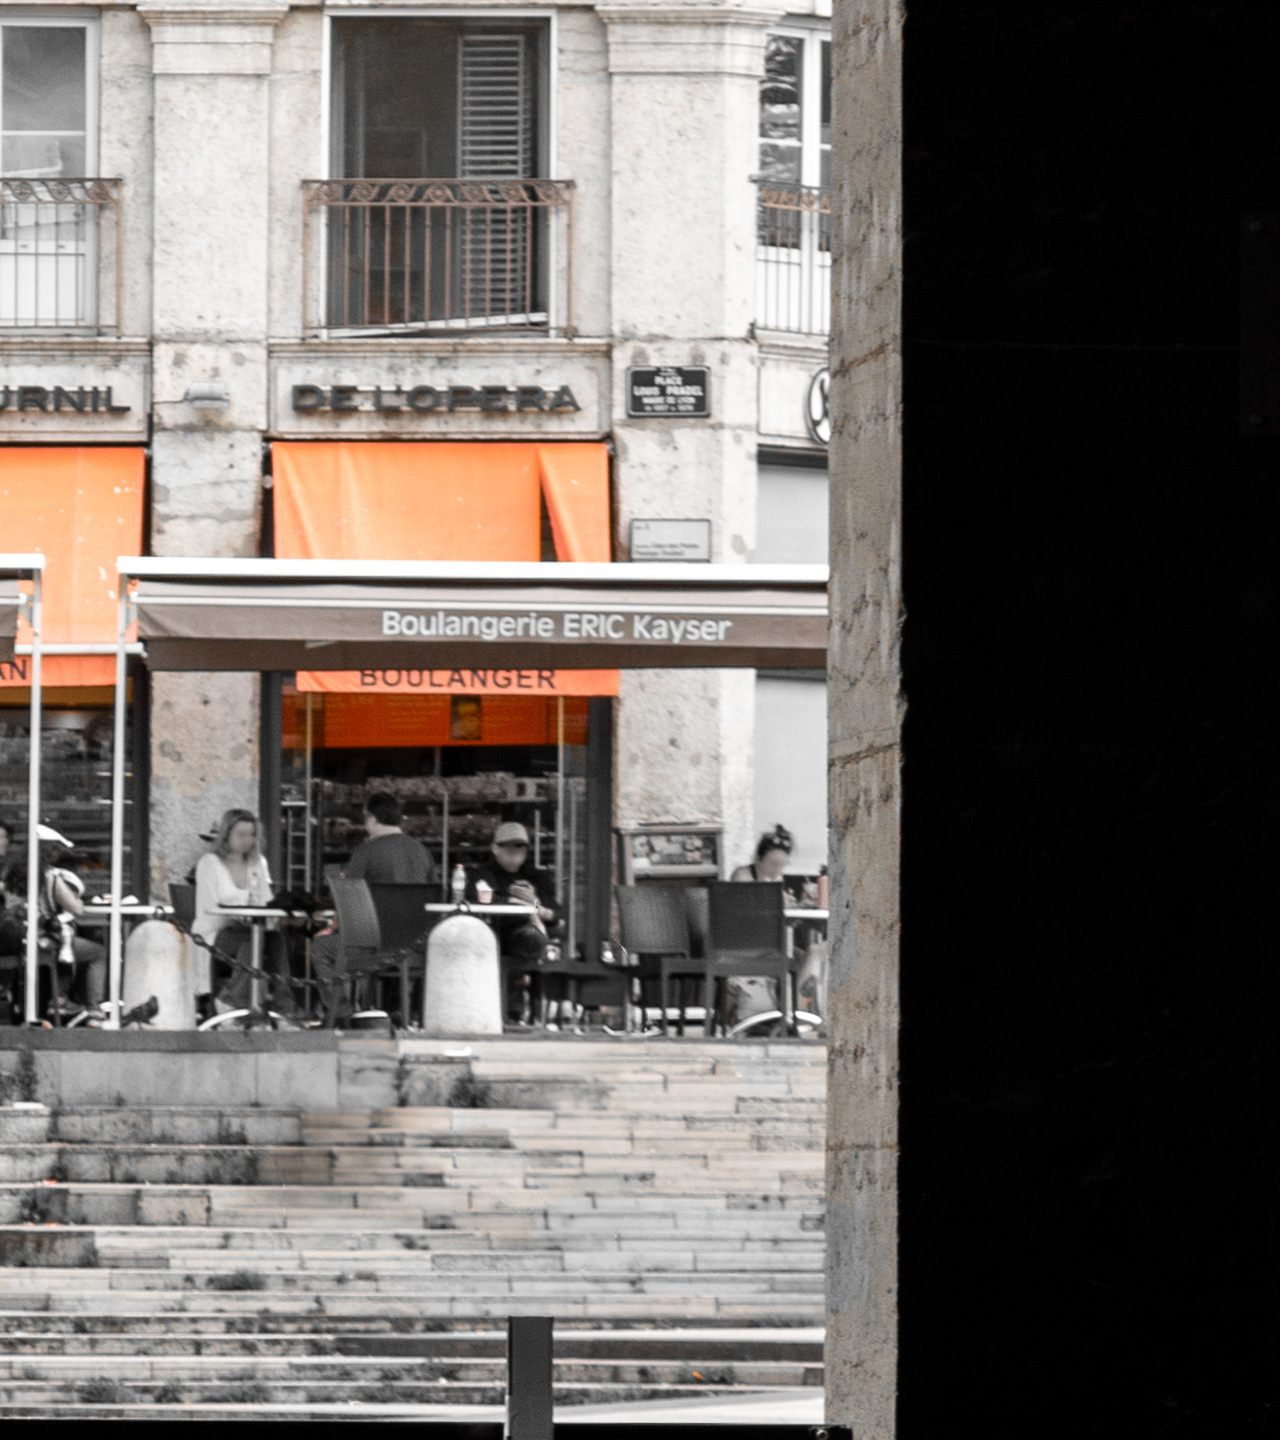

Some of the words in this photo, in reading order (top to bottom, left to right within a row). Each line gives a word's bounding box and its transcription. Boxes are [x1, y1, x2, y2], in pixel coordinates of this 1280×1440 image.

[292, 384, 358, 411] DE
[382, 610, 554, 640] Boulangerie
[562, 612, 625, 639] ERIC
[633, 614, 733, 644] Kayser
[359, 669, 556, 689] BOULANGER
